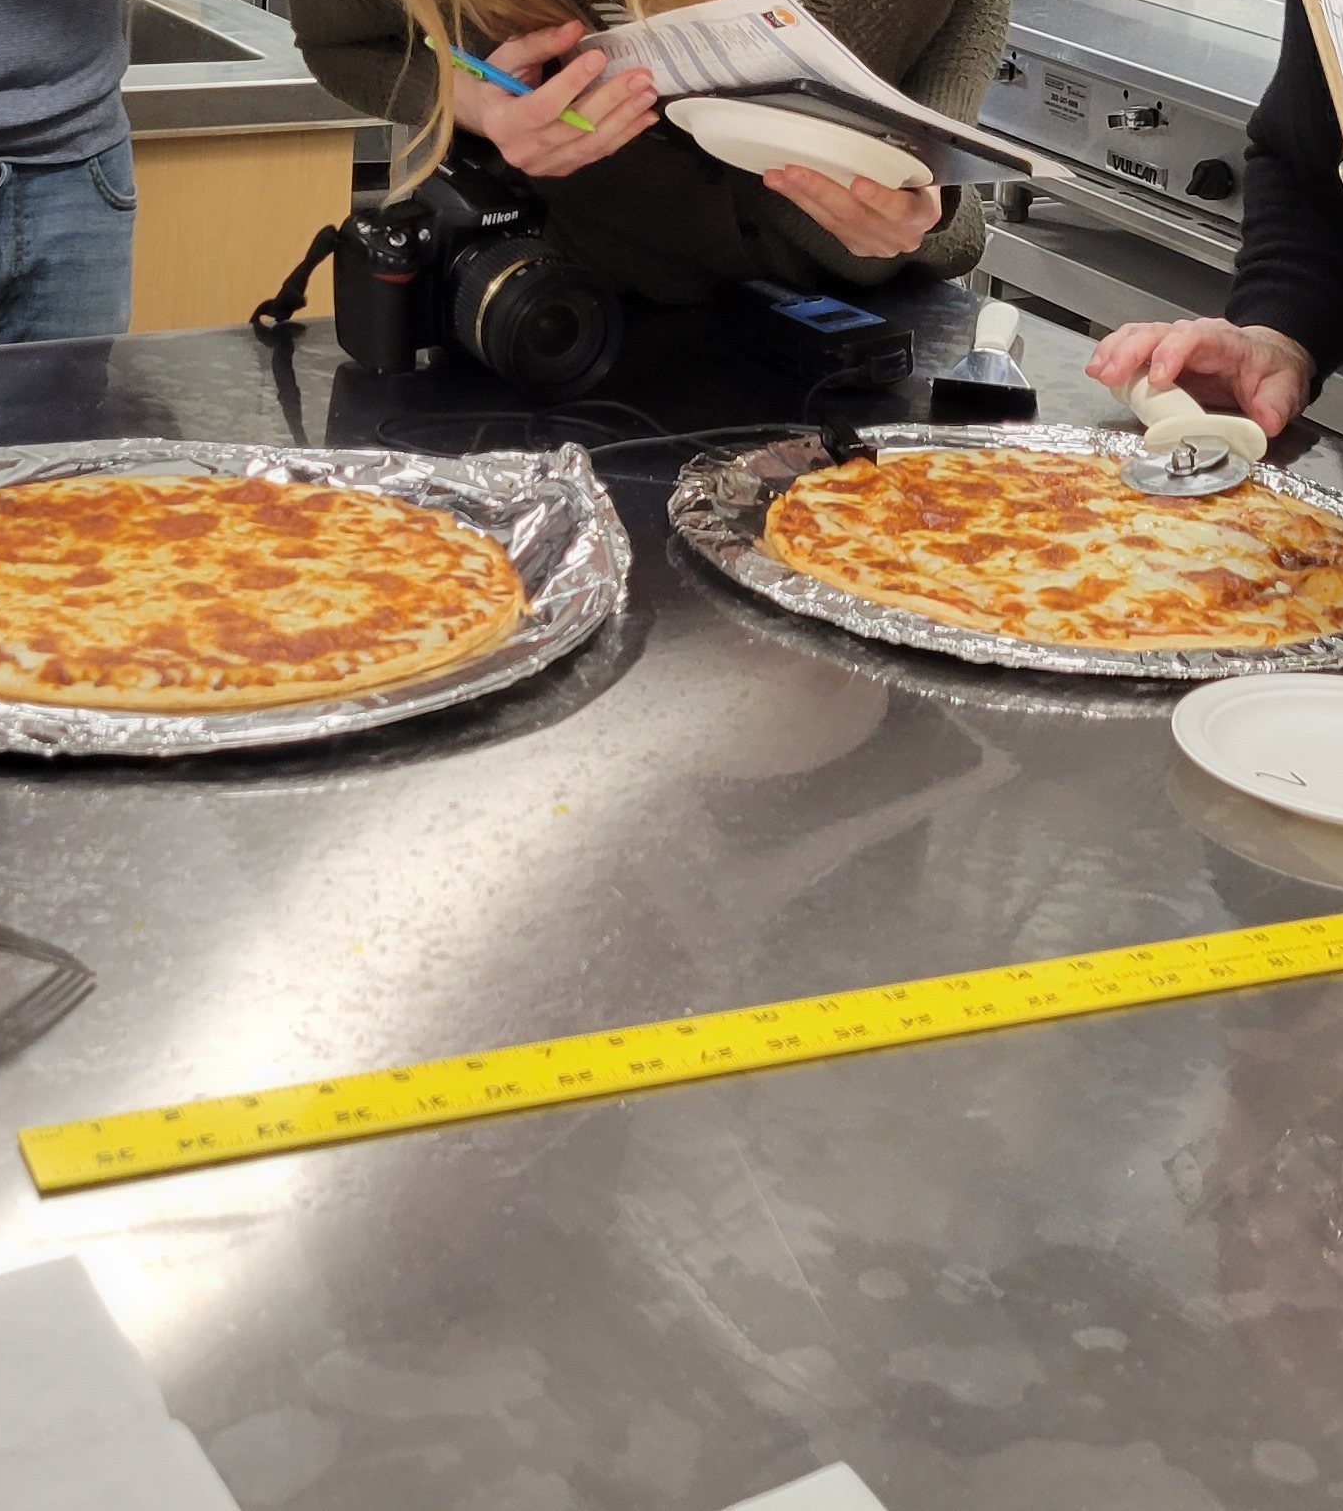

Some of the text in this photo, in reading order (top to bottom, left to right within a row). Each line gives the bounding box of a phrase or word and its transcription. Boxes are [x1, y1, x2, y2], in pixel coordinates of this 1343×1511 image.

[1112, 154, 1157, 185] VULCAN
[481, 210, 519, 226] Nikon
[753, 1010, 779, 1023] 10
[817, 1000, 839, 1012] 11
[882, 988, 907, 1002] 12
[945, 978, 971, 990] 13
[1007, 969, 1033, 981] 14
[1068, 959, 1094, 971] 15
[1128, 950, 1154, 962] 16
[1186, 941, 1208, 953] 17
[1243, 932, 1270, 945] 18
[1300, 923, 1327, 935] 19
